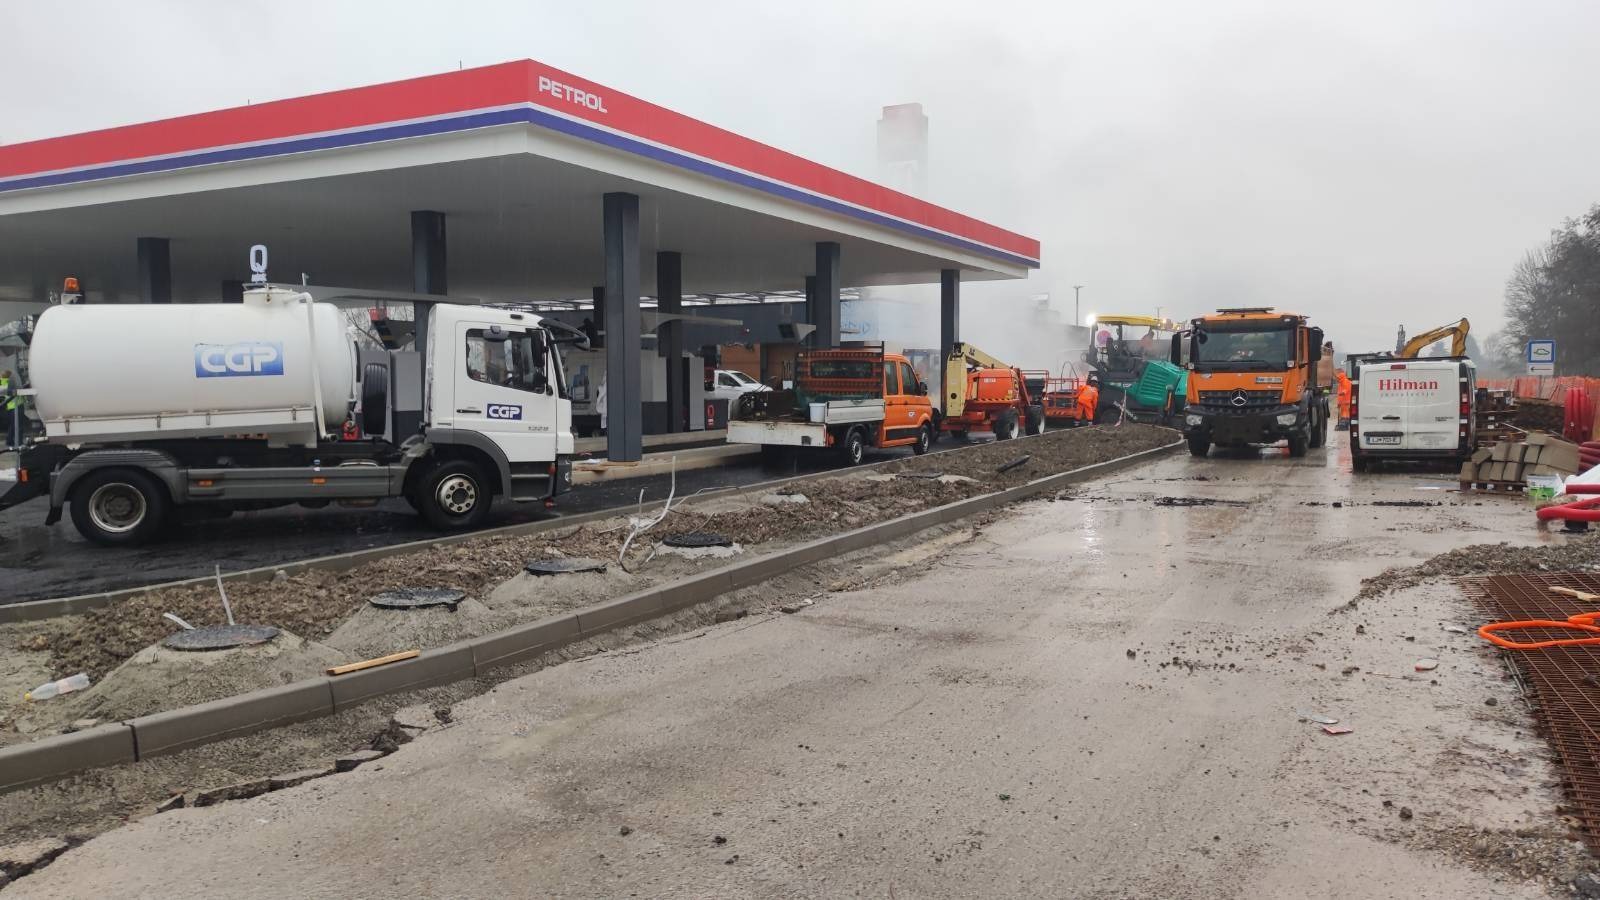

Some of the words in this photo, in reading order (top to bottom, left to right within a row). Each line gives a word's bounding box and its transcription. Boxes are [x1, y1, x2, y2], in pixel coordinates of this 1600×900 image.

[539, 76, 608, 113] PETROL
[250, 244, 268, 273] Q
[201, 346, 277, 373] CGP
[1379, 379, 1438, 390] Hilman
[489, 406, 520, 418] CGP
